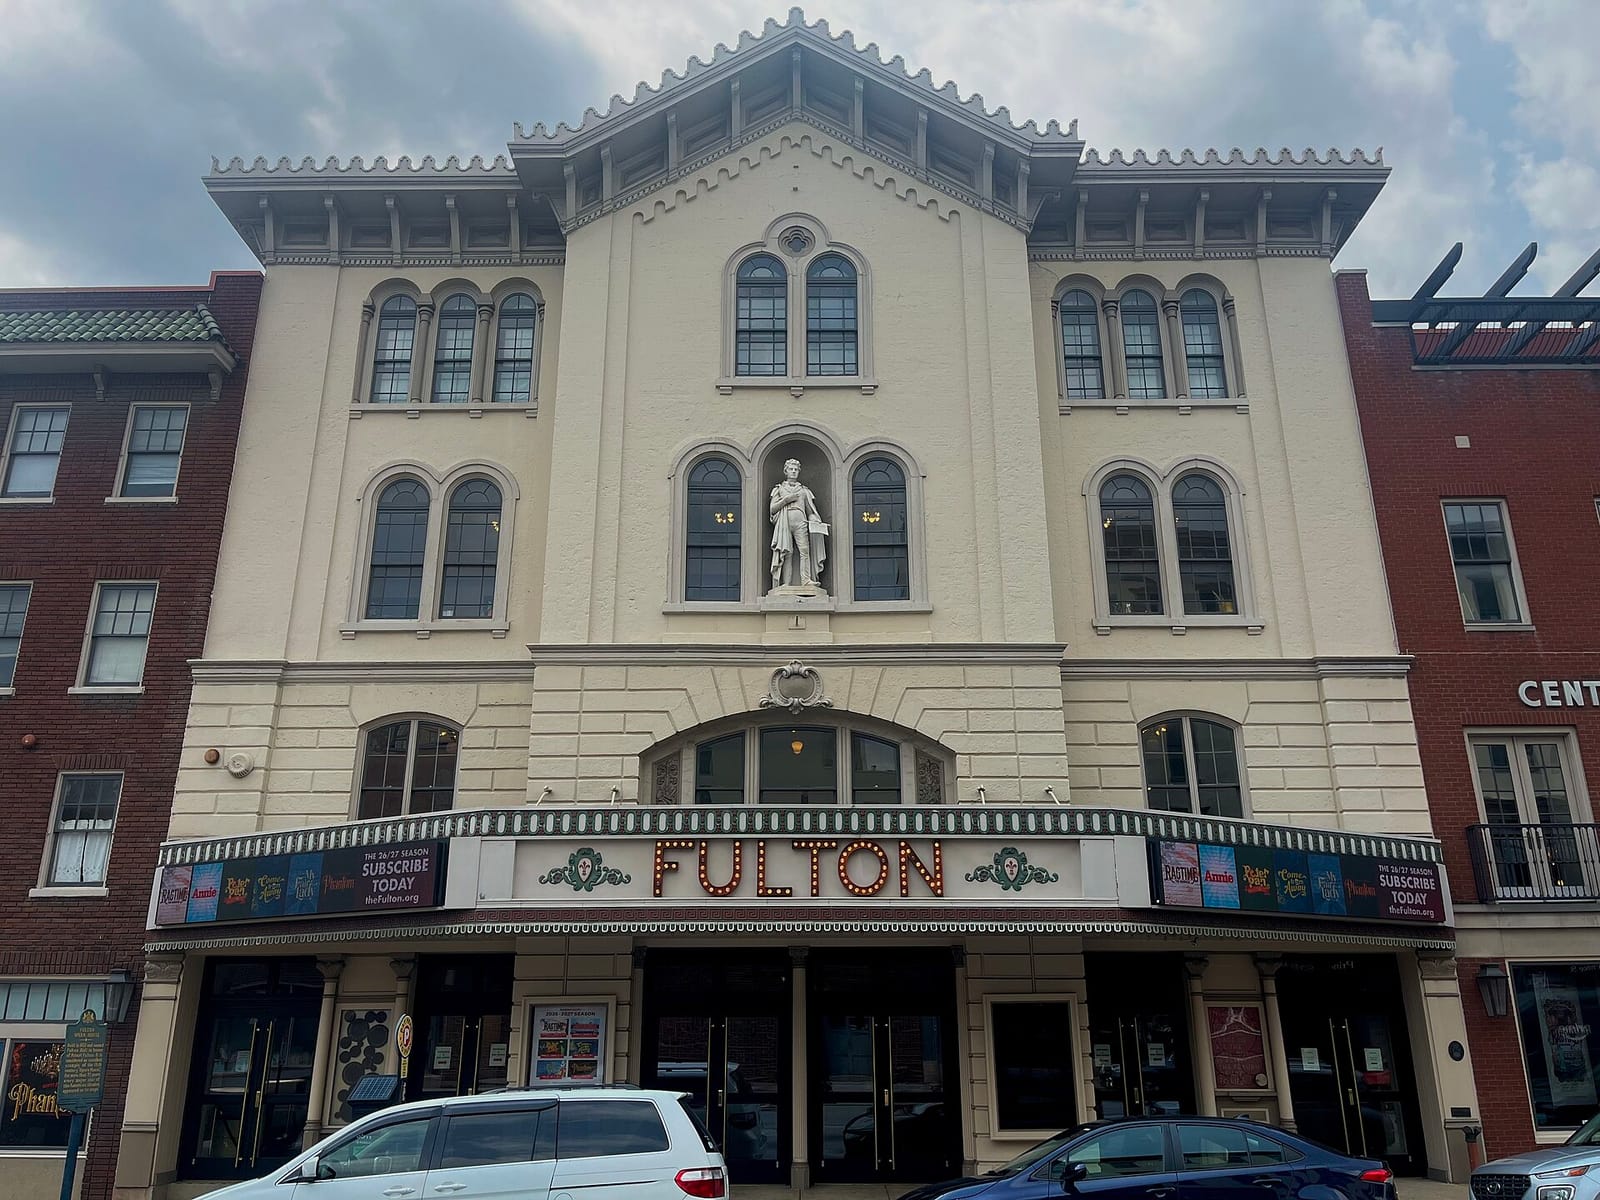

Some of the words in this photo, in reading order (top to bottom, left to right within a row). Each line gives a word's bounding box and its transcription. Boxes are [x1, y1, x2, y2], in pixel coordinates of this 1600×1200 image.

[1518, 680, 1600, 707] CENT
[365, 852, 377, 860] THE
[379, 850, 400, 860] 26/27
[401, 848, 429, 857] SEASON
[362, 858, 429, 877] SUBSCRIBE
[653, 839, 944, 897] FULTON
[1164, 864, 1199, 884] RAGTIME
[1278, 868, 1307, 881] Come
[1378, 865, 1390, 873] THE
[1390, 866, 1408, 874] 26/27
[1410, 867, 1433, 876] SEASON
[1205, 870, 1234, 883] Annie
[1379, 874, 1436, 890] SUBSCRIBE
[372, 877, 416, 893] TODAY
[192, 887, 217, 899] Annie
[365, 893, 419, 904] theFulton.org
[1391, 890, 1428, 905] TODAY
[1389, 905, 1434, 919] theFulton.org
[8, 1081, 73, 1121] Phan
